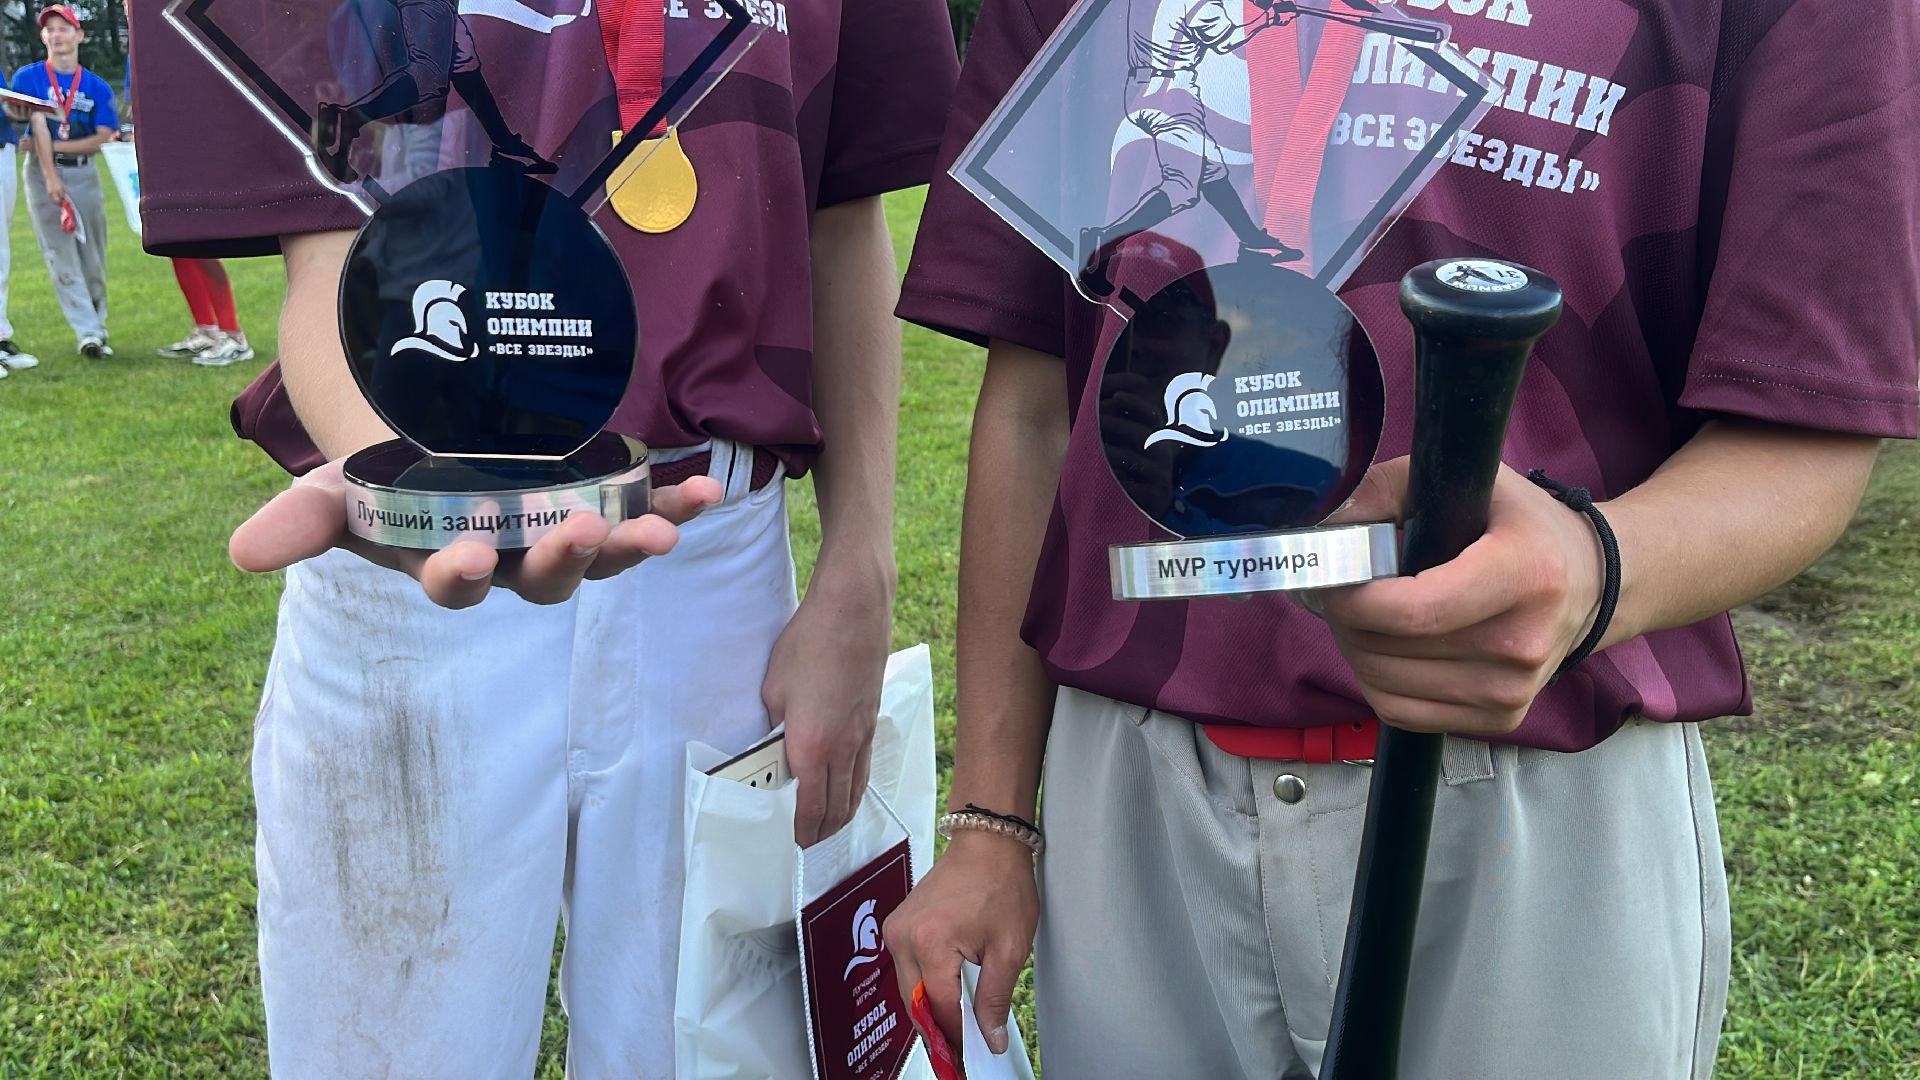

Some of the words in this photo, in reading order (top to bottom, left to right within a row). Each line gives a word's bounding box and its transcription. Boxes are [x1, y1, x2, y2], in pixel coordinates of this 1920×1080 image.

[1352, 32, 1627, 137] ЛИМПИИ
[485, 291, 555, 310] КУБОК
[487, 317, 593, 337] ОЛИМПИИ
[488, 343, 522, 355] «ВСЕ
[527, 344, 594, 358] ЗВЕЗДЫ»
[1234, 370, 1302, 394] КУБОК
[1236, 391, 1340, 418] ОЛИМПИИ
[1238, 422, 1271, 435] «ВСЕ
[1276, 416, 1341, 432] ЗВЕЗДЫ»
[357, 500, 434, 531] Лучший
[1158, 557, 1206, 579] MVP
[1213, 552, 1319, 580] турнира
[853, 1000, 887, 1040] КУБОК
[847, 1012, 897, 1067] ОЛИМПИИ
